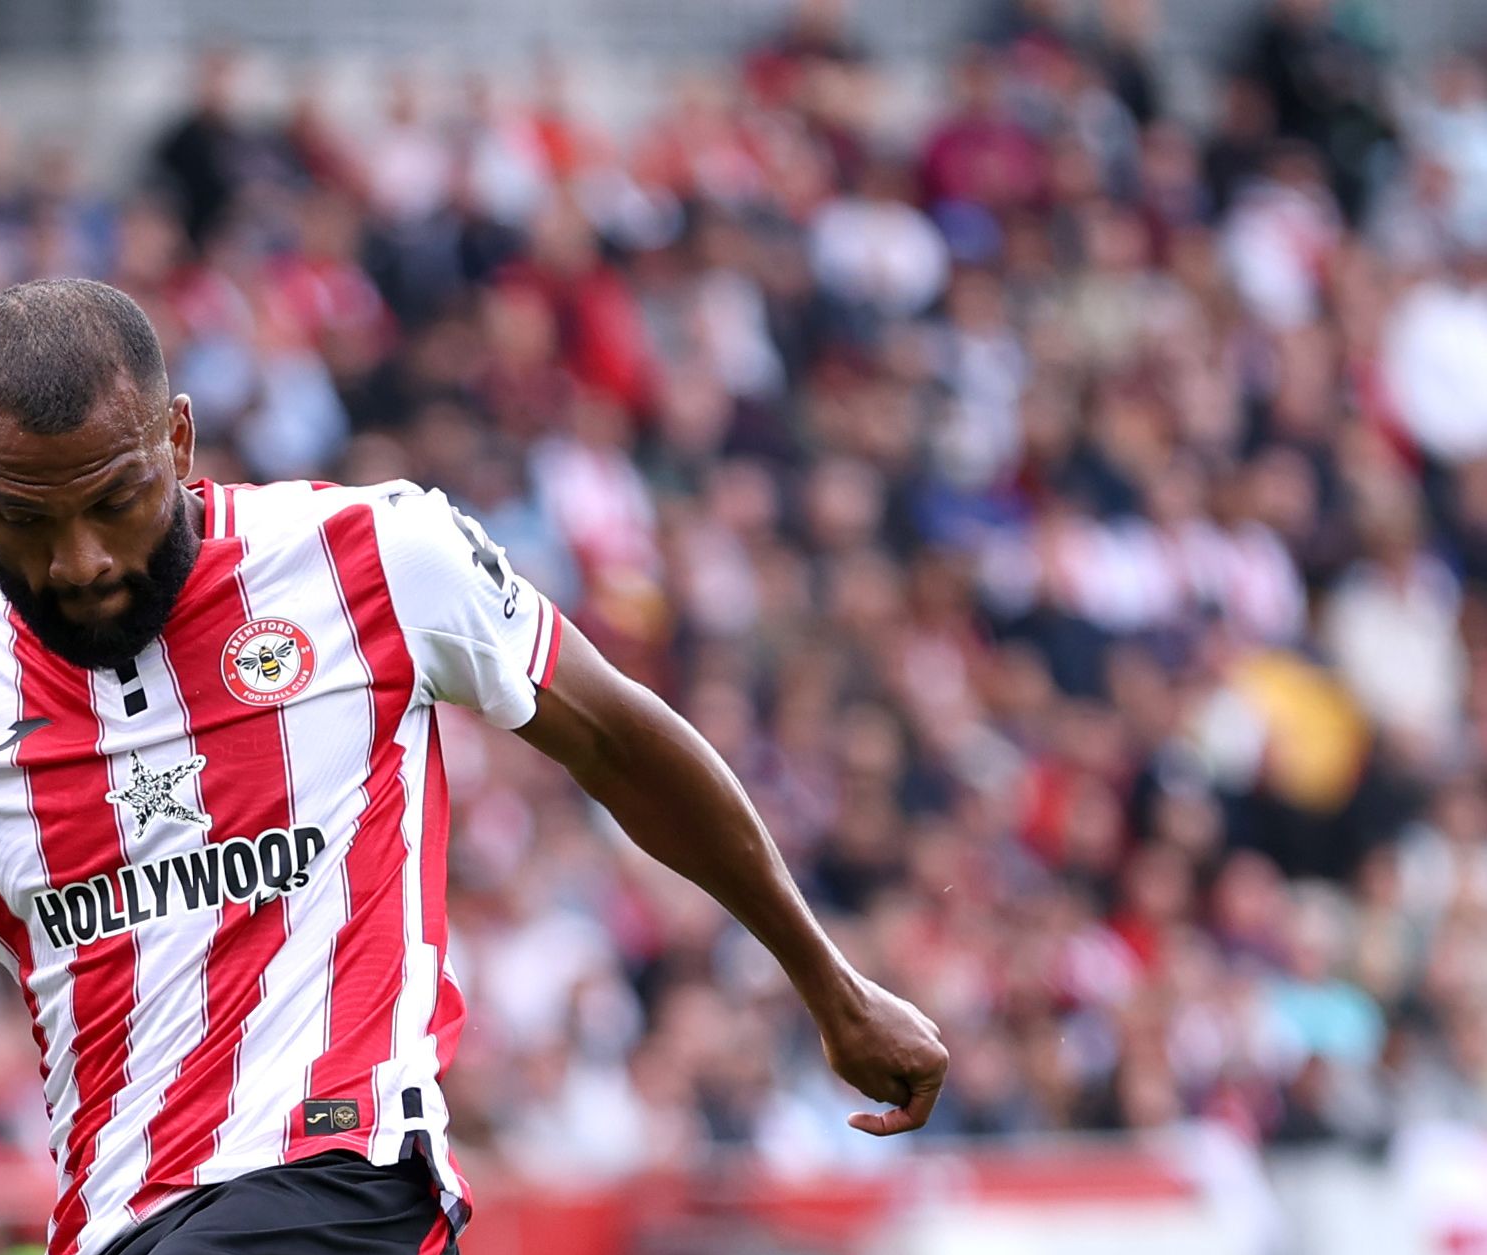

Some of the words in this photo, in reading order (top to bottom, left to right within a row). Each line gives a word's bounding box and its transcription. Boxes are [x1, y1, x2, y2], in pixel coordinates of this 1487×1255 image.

[227, 621, 294, 656] BRENTFORD
[242, 690, 293, 702] FOOTBALL
[291, 669, 310, 692] CLUB
[34, 825, 327, 949] HOLLYWOOD
